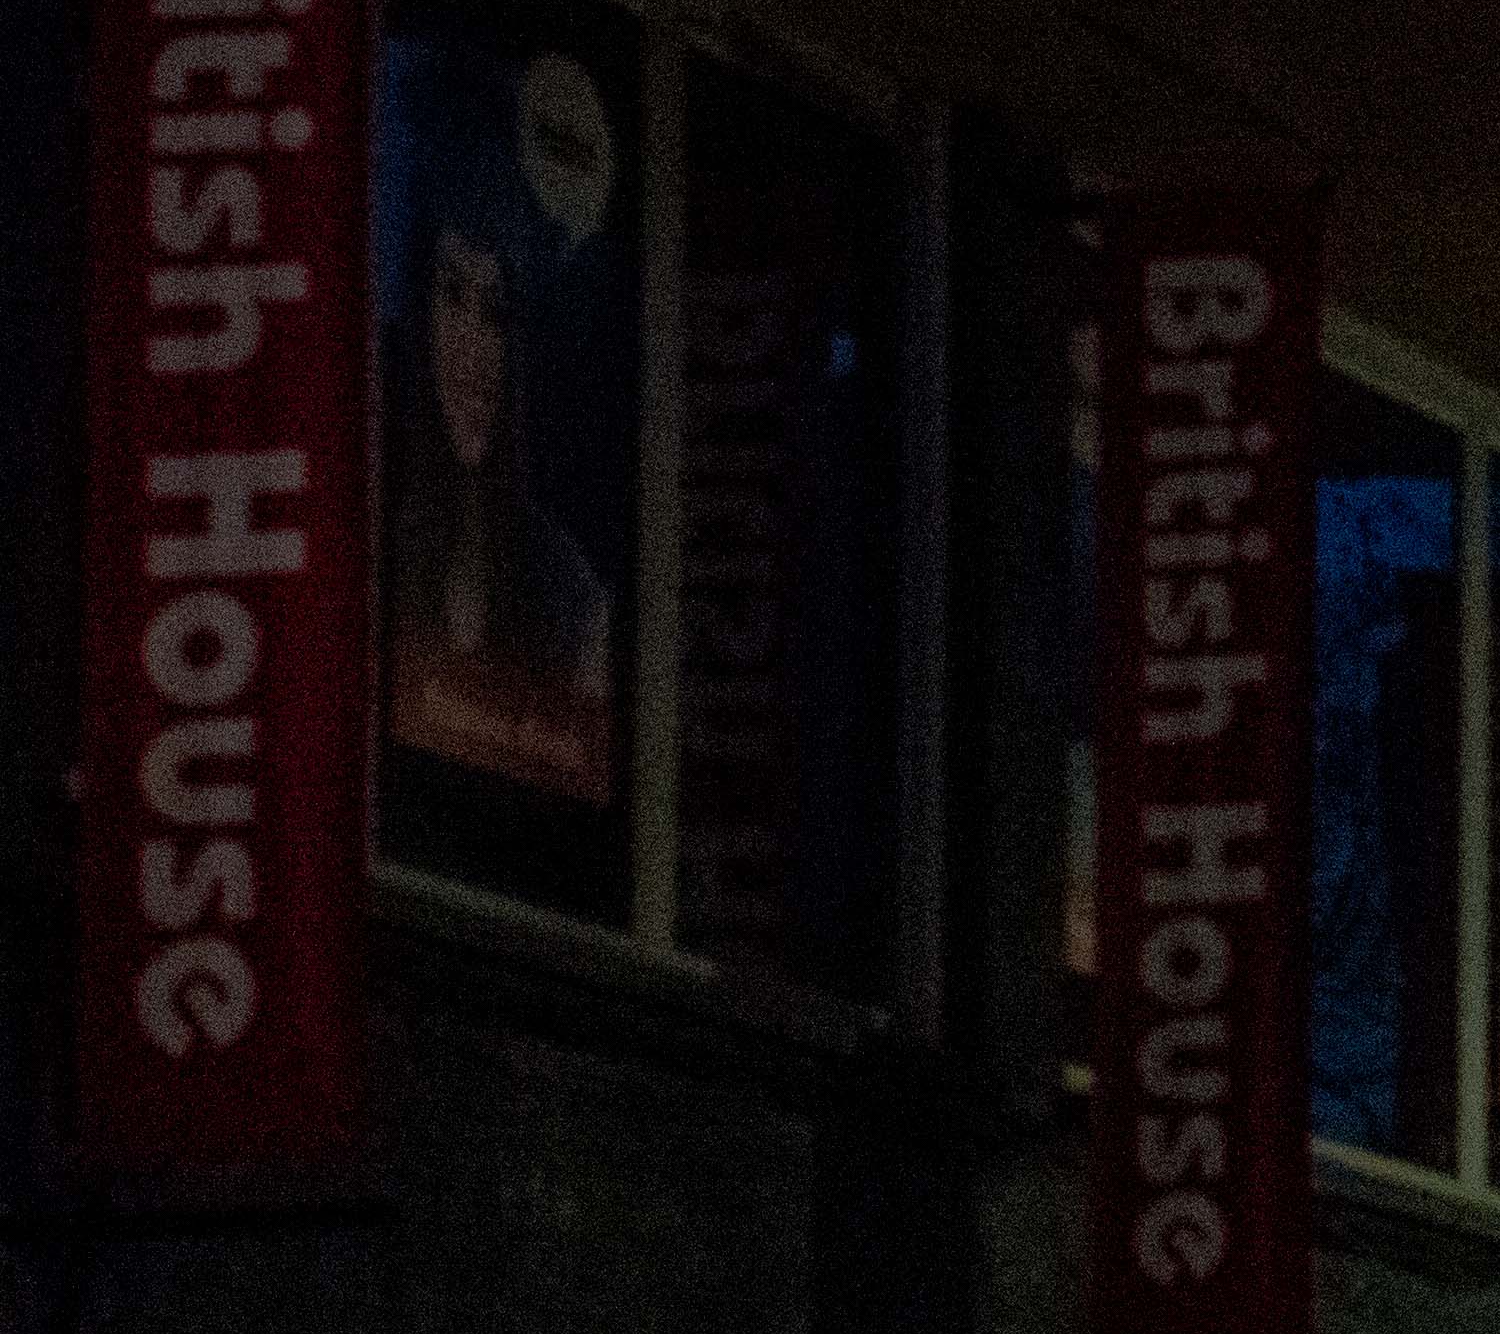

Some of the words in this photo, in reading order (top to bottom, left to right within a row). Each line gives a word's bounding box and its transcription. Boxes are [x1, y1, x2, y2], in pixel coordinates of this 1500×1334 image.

[1141, 253, 1275, 745] British
[134, 447, 309, 1061] House
[1131, 801, 1267, 1287] House
